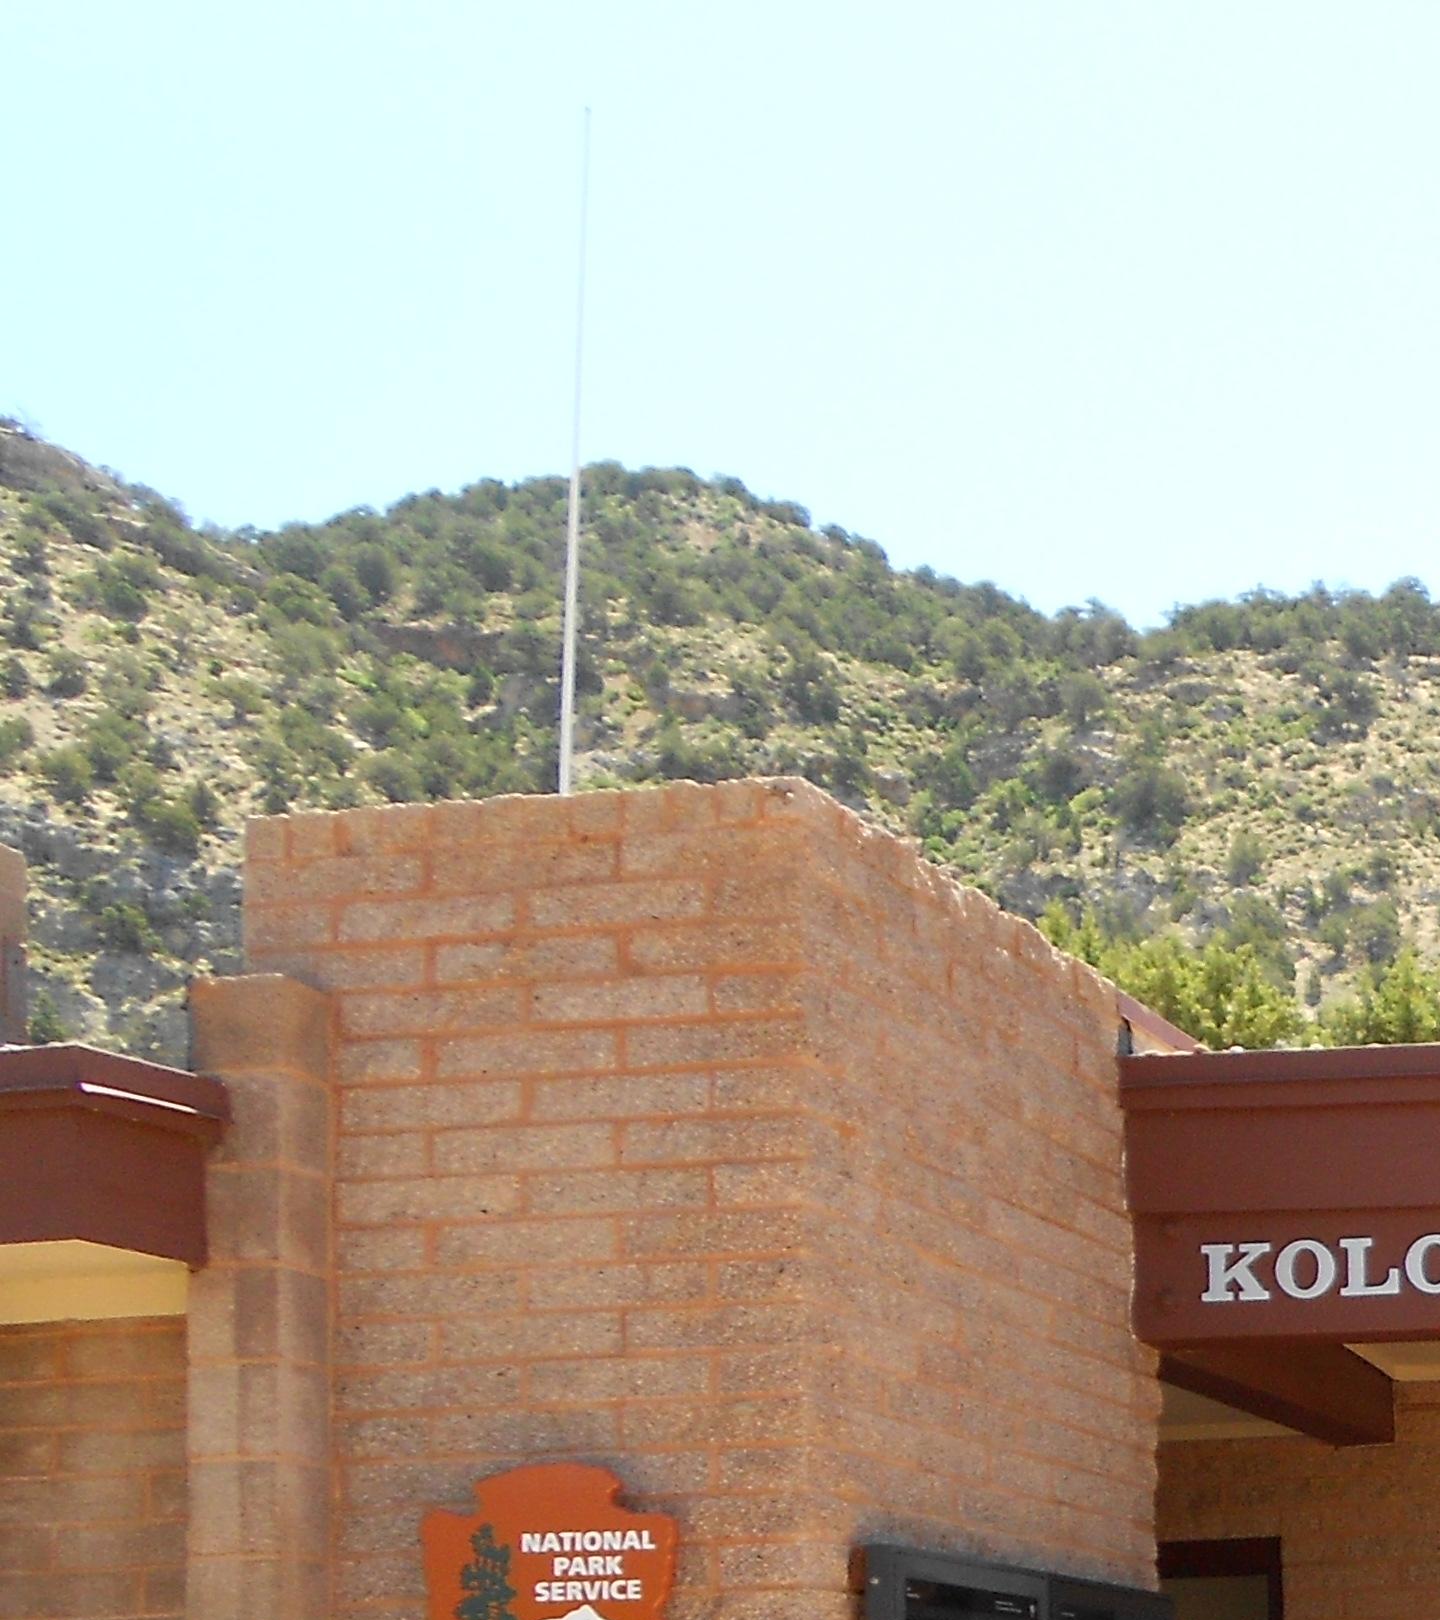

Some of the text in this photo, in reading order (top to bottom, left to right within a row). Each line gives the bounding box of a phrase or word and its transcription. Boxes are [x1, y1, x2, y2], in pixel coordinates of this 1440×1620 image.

[521, 1530, 656, 1553] NATIONAL
[553, 1556, 623, 1576] PARK
[535, 1579, 642, 1602] SERVICE
